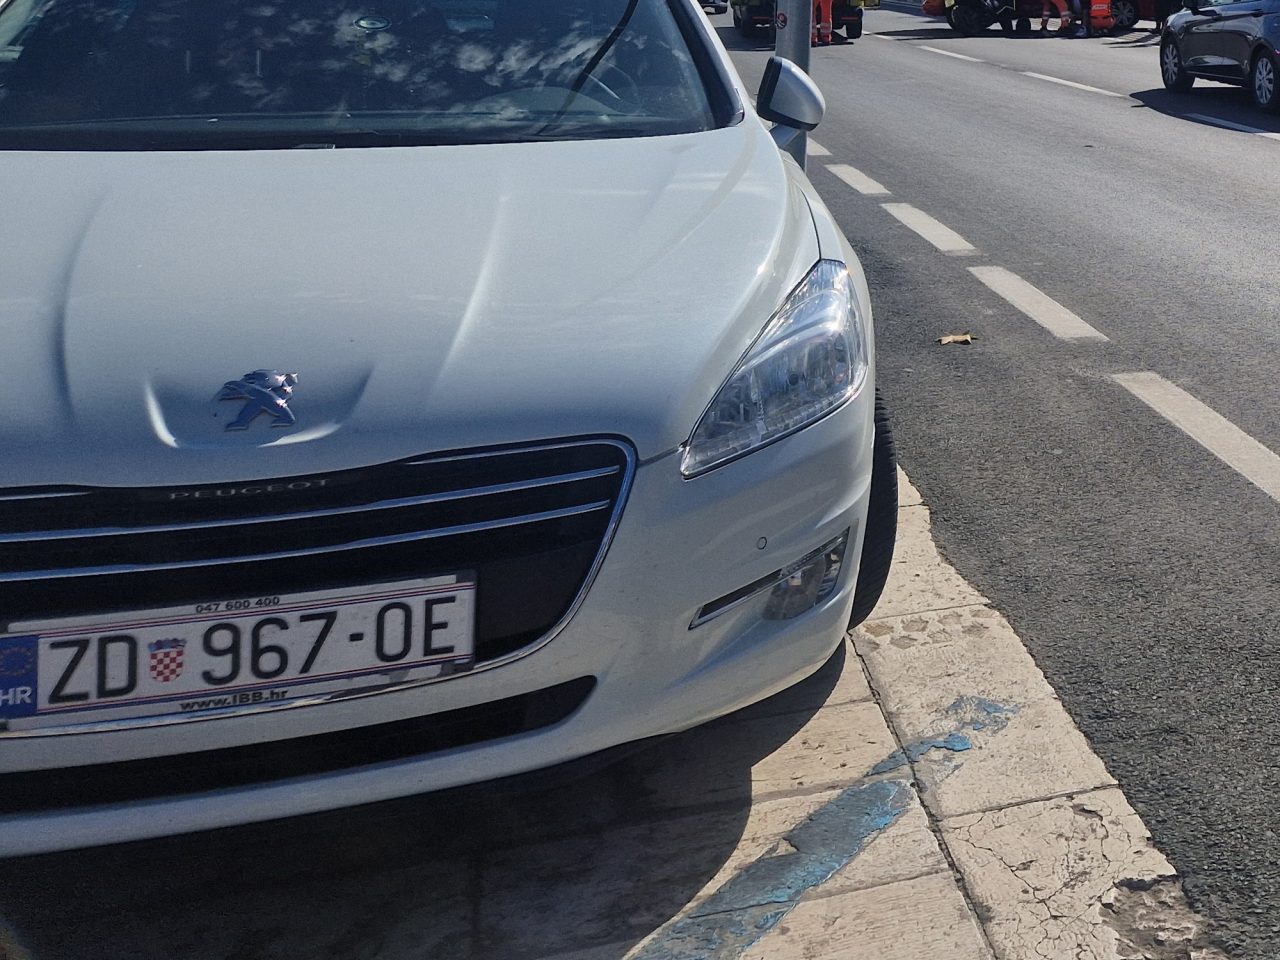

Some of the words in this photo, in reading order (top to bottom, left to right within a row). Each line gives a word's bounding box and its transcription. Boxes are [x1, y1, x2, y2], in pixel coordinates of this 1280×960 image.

[170, 479, 329, 499] PEUGEOT
[225, 600, 250, 610] 600
[256, 596, 280, 607] 400
[48, 635, 137, 704] ZD
[202, 596, 456, 686] 967-OE
[0, 686, 32, 706] HR
[180, 689, 288, 710] www.IBB.hr
